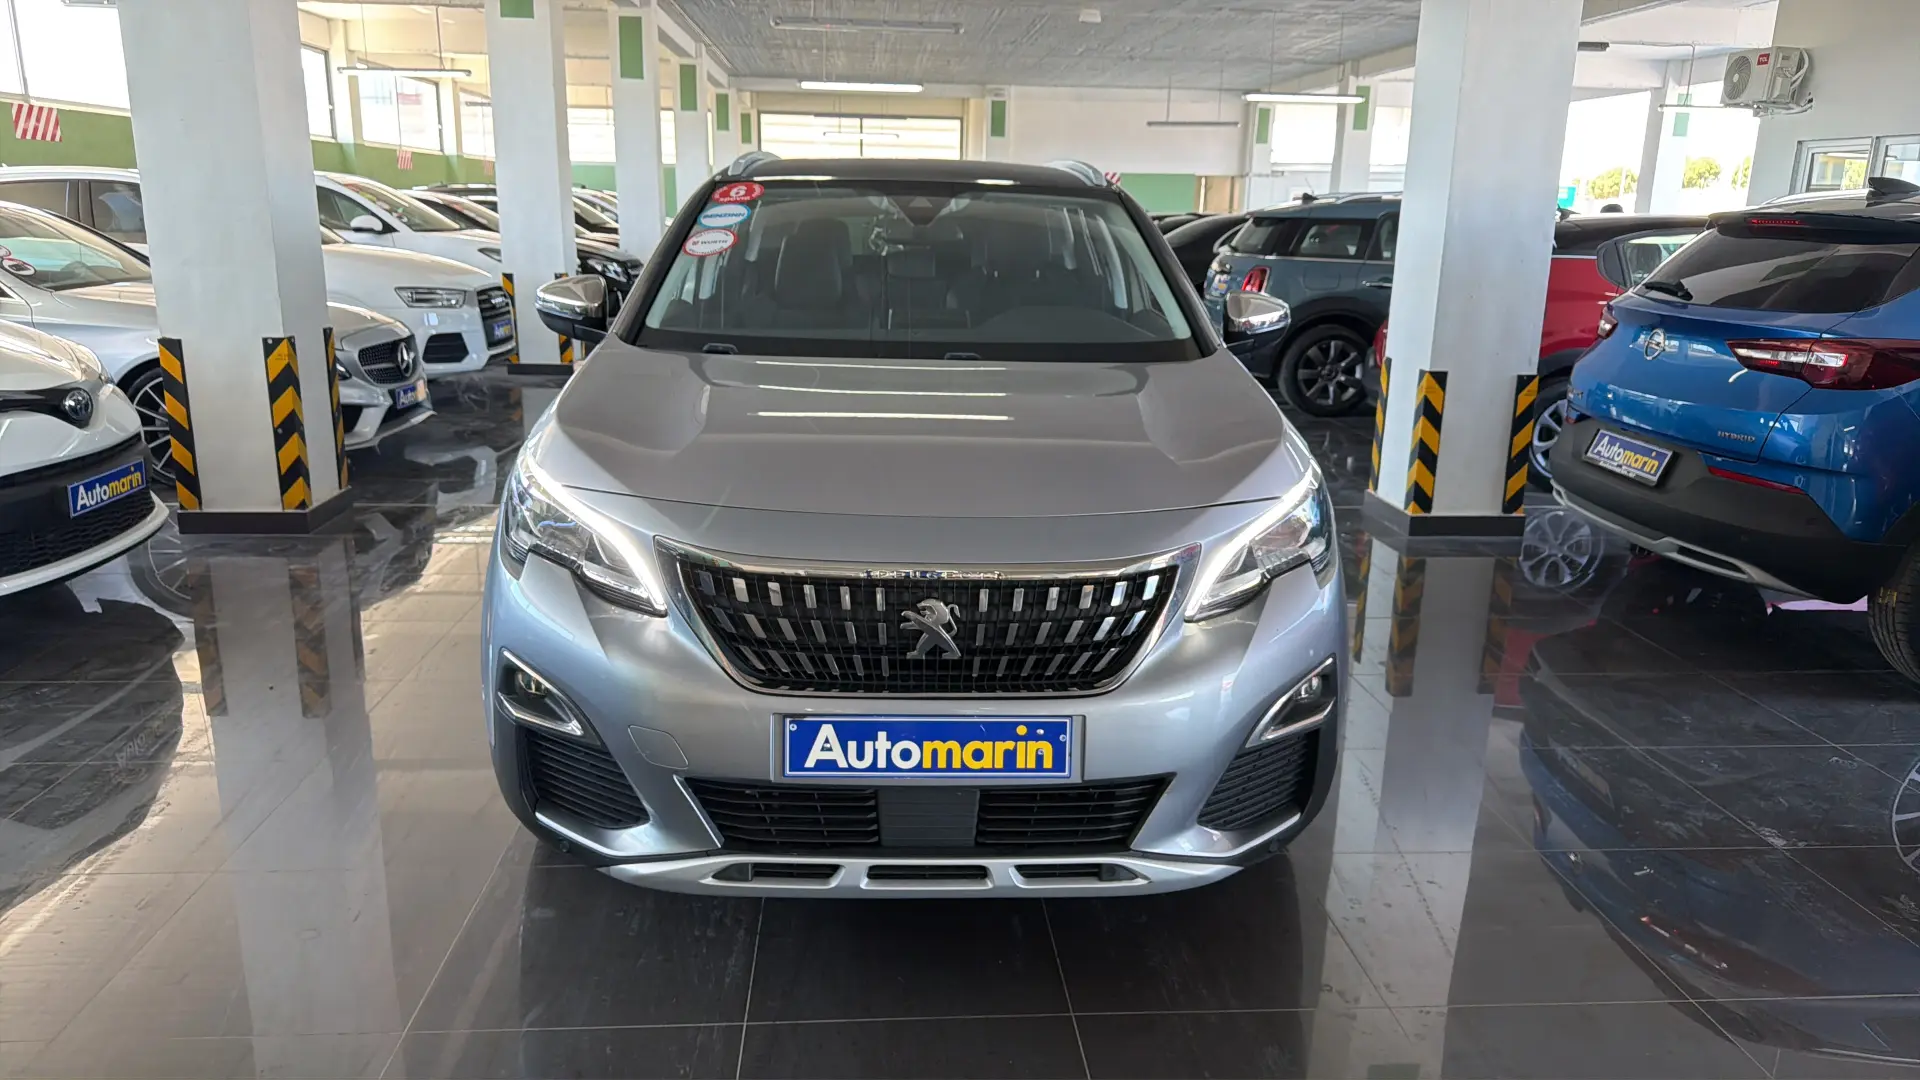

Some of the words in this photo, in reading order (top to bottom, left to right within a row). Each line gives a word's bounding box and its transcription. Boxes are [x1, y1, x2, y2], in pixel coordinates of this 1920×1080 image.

[730, 186, 747, 197] 6
[1593, 436, 1659, 474] Automarin
[1717, 430, 1756, 442] HYBRID
[77, 466, 142, 511] Automarin
[803, 723, 1053, 769] Automarin
